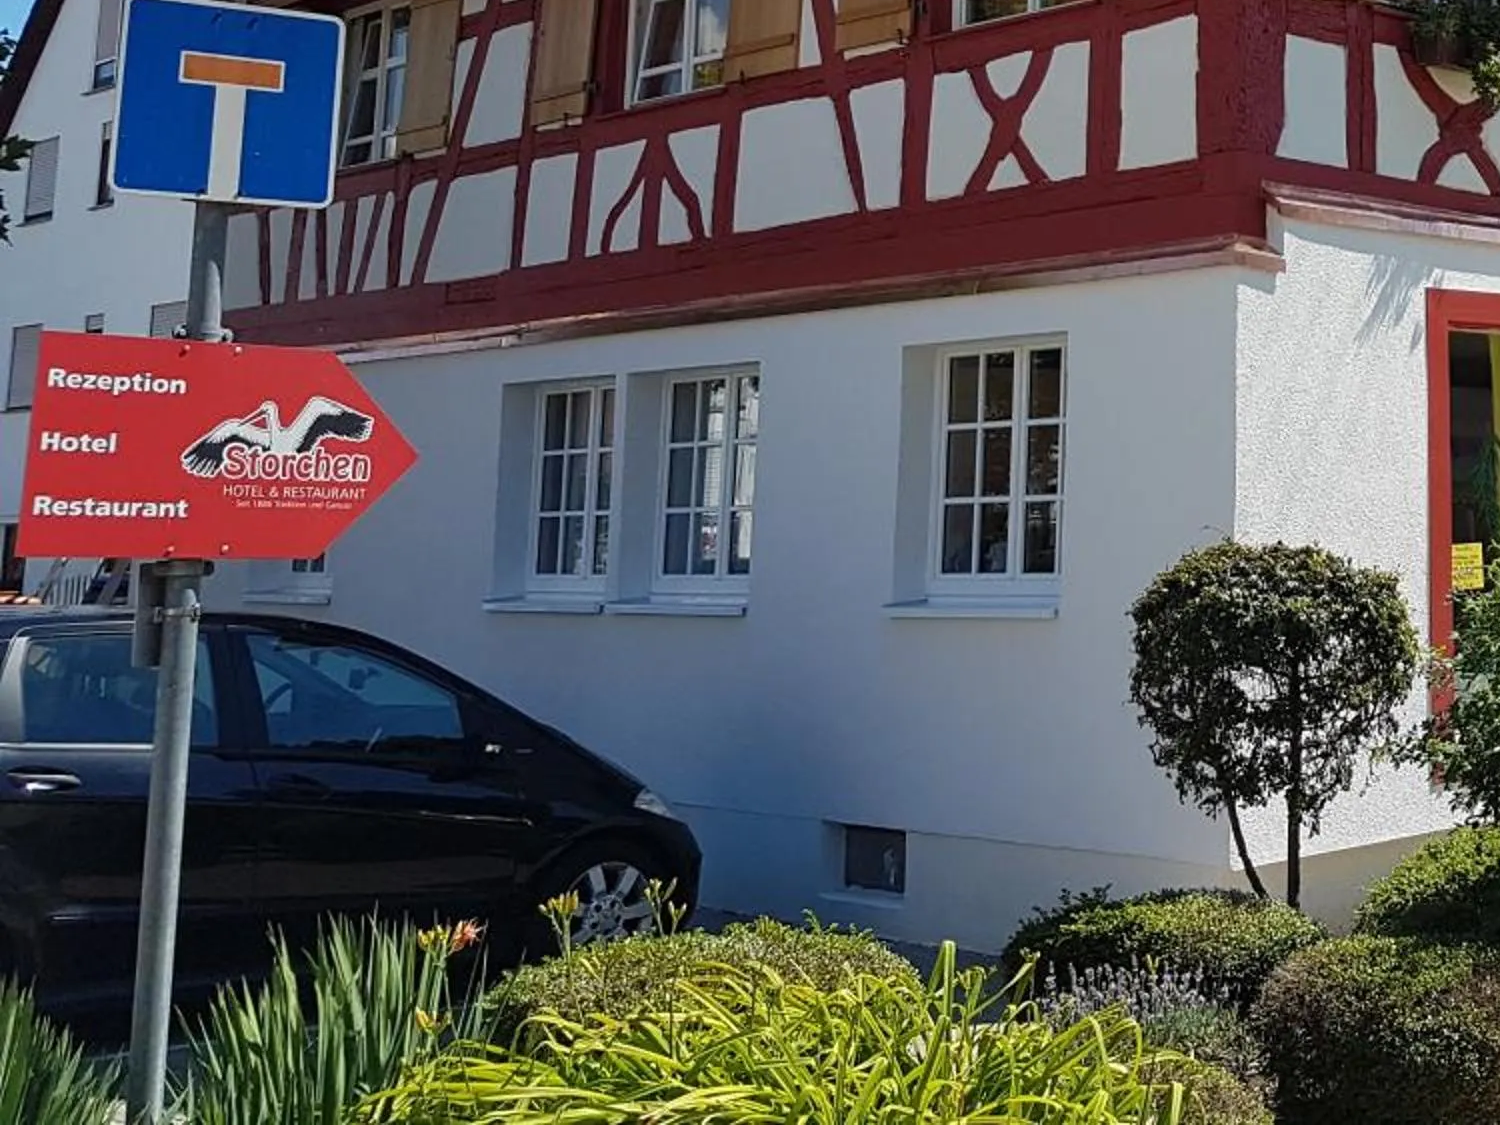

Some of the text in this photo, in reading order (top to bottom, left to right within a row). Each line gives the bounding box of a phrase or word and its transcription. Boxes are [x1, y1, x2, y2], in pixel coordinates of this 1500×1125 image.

[47, 368, 187, 396] Rezeption
[40, 431, 118, 454] Hotel
[222, 442, 371, 482] Storchen
[223, 484, 366, 500] HOTEL & RESTAURANT
[32, 495, 189, 518] Restaurant
